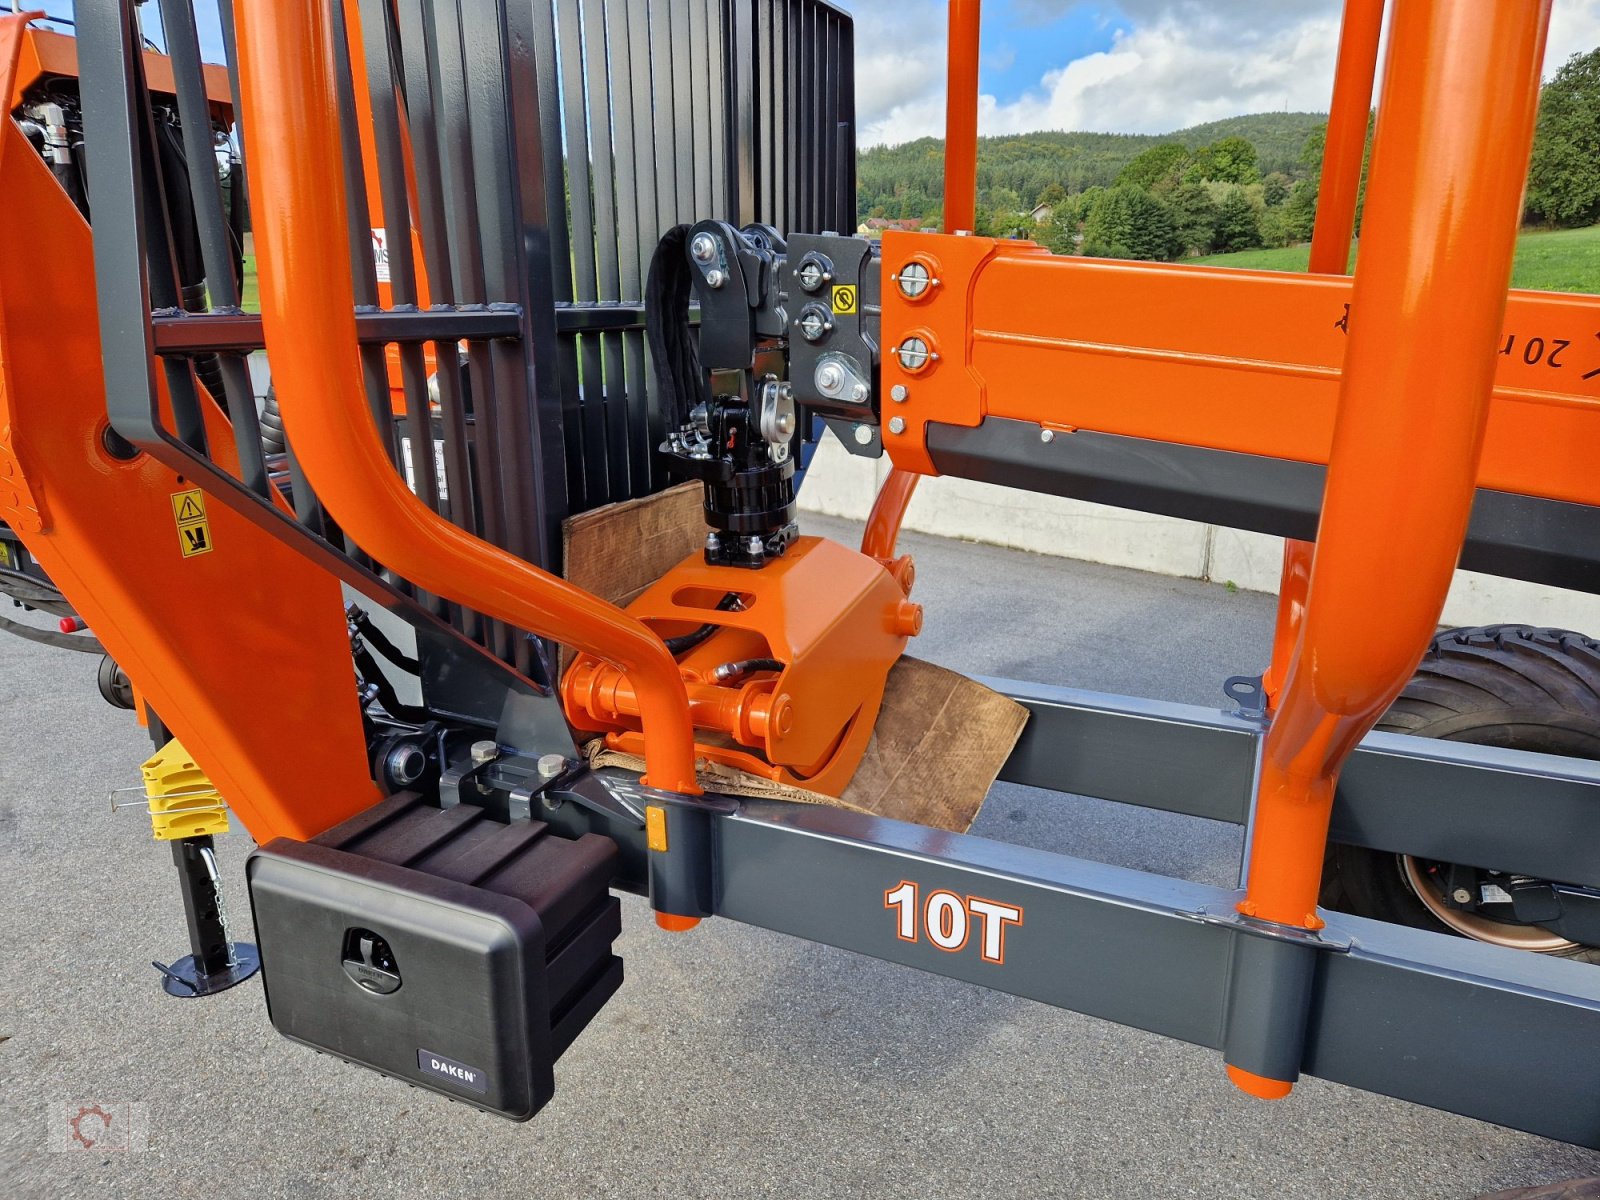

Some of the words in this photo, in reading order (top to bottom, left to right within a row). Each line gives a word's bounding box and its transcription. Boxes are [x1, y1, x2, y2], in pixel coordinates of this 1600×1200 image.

[1523, 337, 1571, 367] 20
[884, 879, 1025, 965] 10T
[431, 1058, 474, 1083] DAKEN
